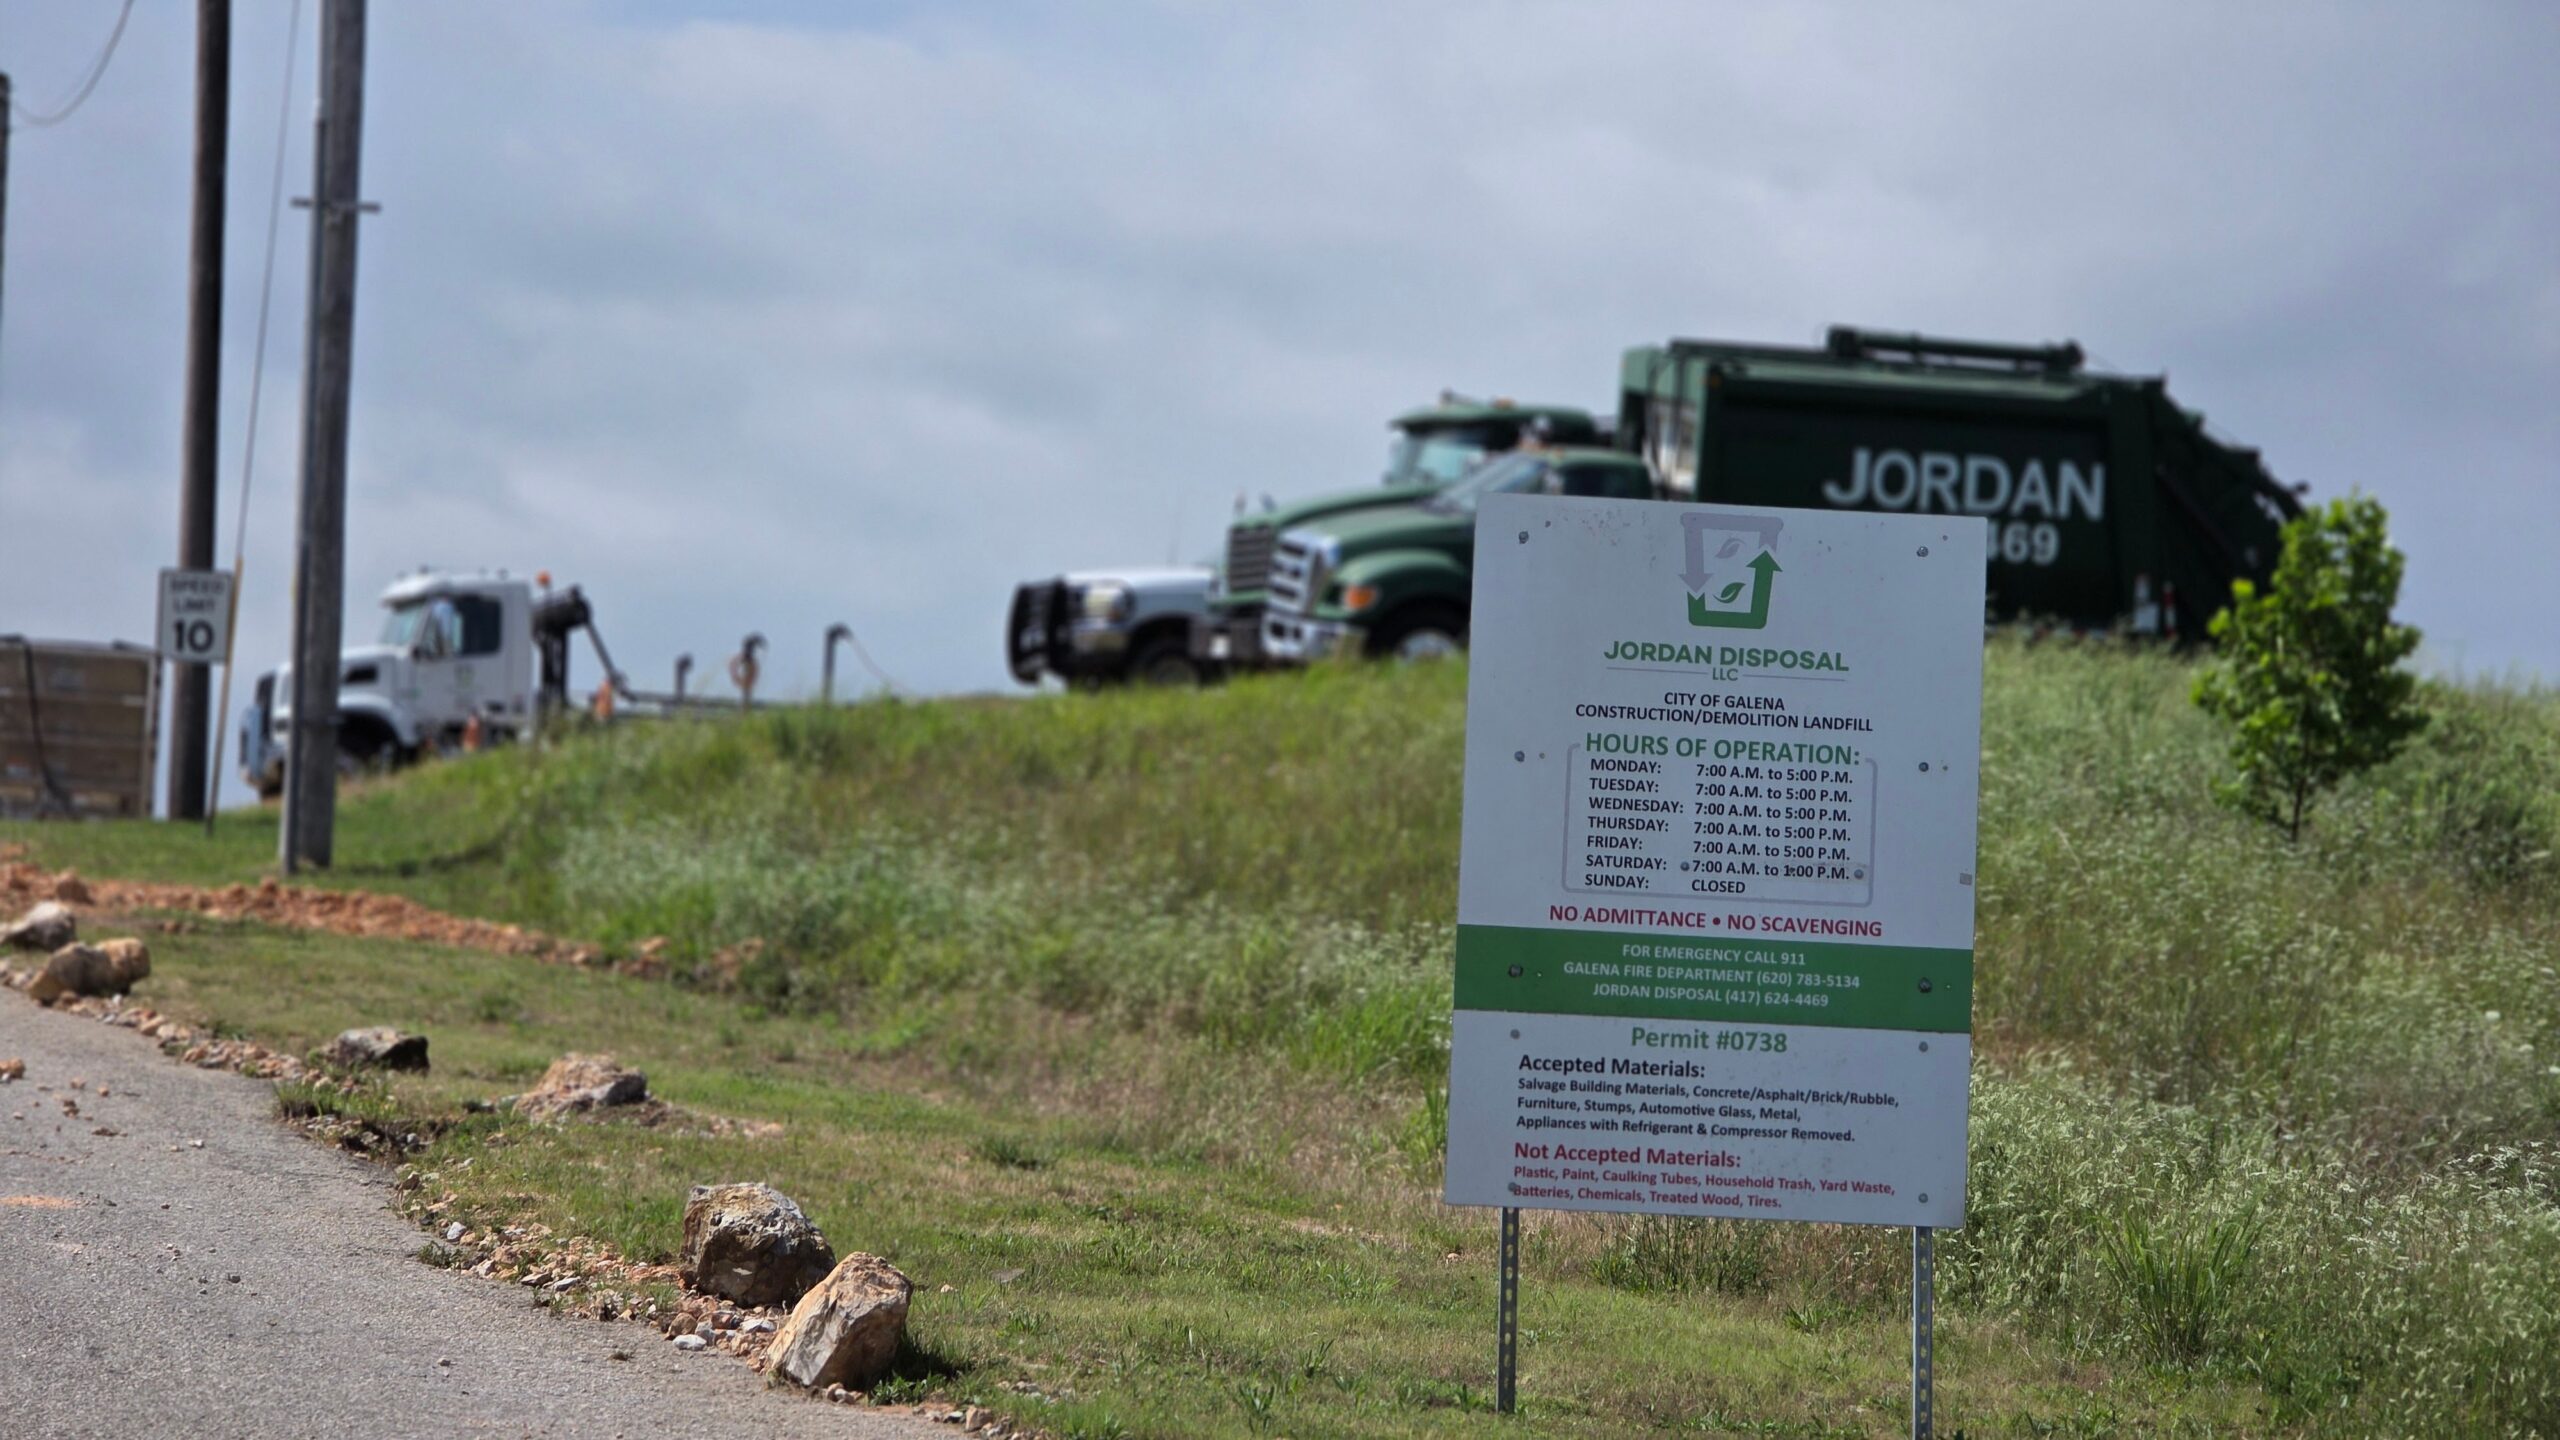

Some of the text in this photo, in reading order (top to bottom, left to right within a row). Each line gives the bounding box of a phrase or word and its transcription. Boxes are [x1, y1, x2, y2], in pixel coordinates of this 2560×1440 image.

[1822, 447, 2105, 520] JORDAN
[174, 619, 215, 654] 10
[1603, 640, 1850, 672] JORDAN DISPOSAL
[1712, 667, 1739, 682] LLC
[1664, 692, 1785, 711] CITY OF GALENA
[1575, 703, 1873, 732] CONSTRUCTION/DEMOLITION LANDFILL
[1586, 732, 1860, 766] HOURS OF OPERATION:
[1590, 758, 1853, 784] MONDAY: 7:00 A.M. to 5:00 P.M.
[1589, 777, 1852, 803] TUESDAY: 7:00 A.M. to 5:00 P.M.
[1588, 796, 1851, 823] WEDNESDAY: 7:00 A.M. to 5:00 P.M.
[1587, 815, 1851, 842] THURSDAY: 7:00 A.M. to 5:00 P.M.
[1587, 835, 1850, 861] FRIDAY: 7:00 A.M. to 5:00 P.M.
[1585, 854, 1850, 880] SATURDAY: 7:00 A.M. to 1:00 P.M.
[1584, 873, 1746, 894] SUNDAY: CLOSED
[1550, 905, 1882, 937] NO ADMITTANCE NO SCAVENGING
[1622, 944, 1805, 966] FOR EMERGENCY CALL 911
[1563, 961, 1860, 988] GALENA FIRE DEPARTMENT (620) 783-5134
[1593, 983, 1829, 1007] JORDAN DISPOSAL (417) 624-4469
[1631, 1026, 1787, 1053] Permit #0738
[1518, 1054, 1705, 1078] Accepted Materials:
[1518, 1077, 1567, 1094] Salvage
[1570, 1079, 1622, 1097] Building
[1625, 1082, 1690, 1099] Materials,
[1517, 1096, 1801, 1123] Furniture, Stumps, Automotive Glass, Metal,
[1516, 1115, 1855, 1142] Appliances with Refrigerant & Compressor Removed.
[1514, 1142, 1741, 1168] Not Accepted Materials:
[1514, 1165, 1895, 1196] Plastic, Paint, Caulking Tubes, Household Trash, Yard Waste,
[1513, 1182, 1782, 1208] Batteries, Chemicals, Treated Wood, Tires.
